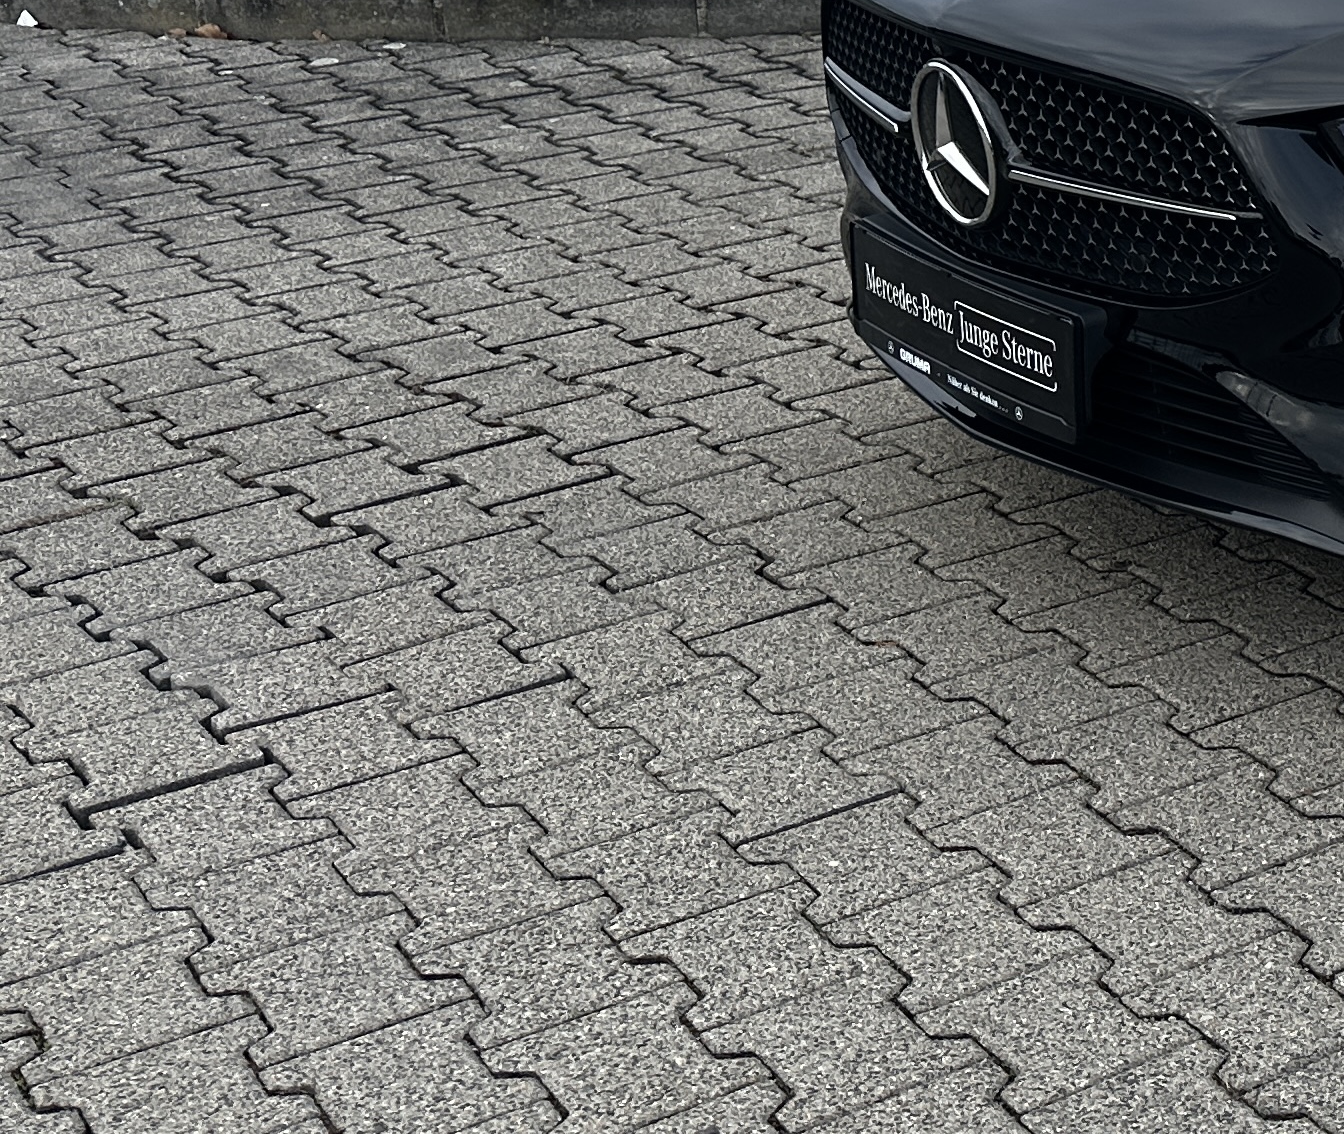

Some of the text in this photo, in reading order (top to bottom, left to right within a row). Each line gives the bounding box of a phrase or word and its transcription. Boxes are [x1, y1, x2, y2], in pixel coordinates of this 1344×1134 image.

[864, 262, 1053, 378] Mercedes-Benz Junge Sterne
